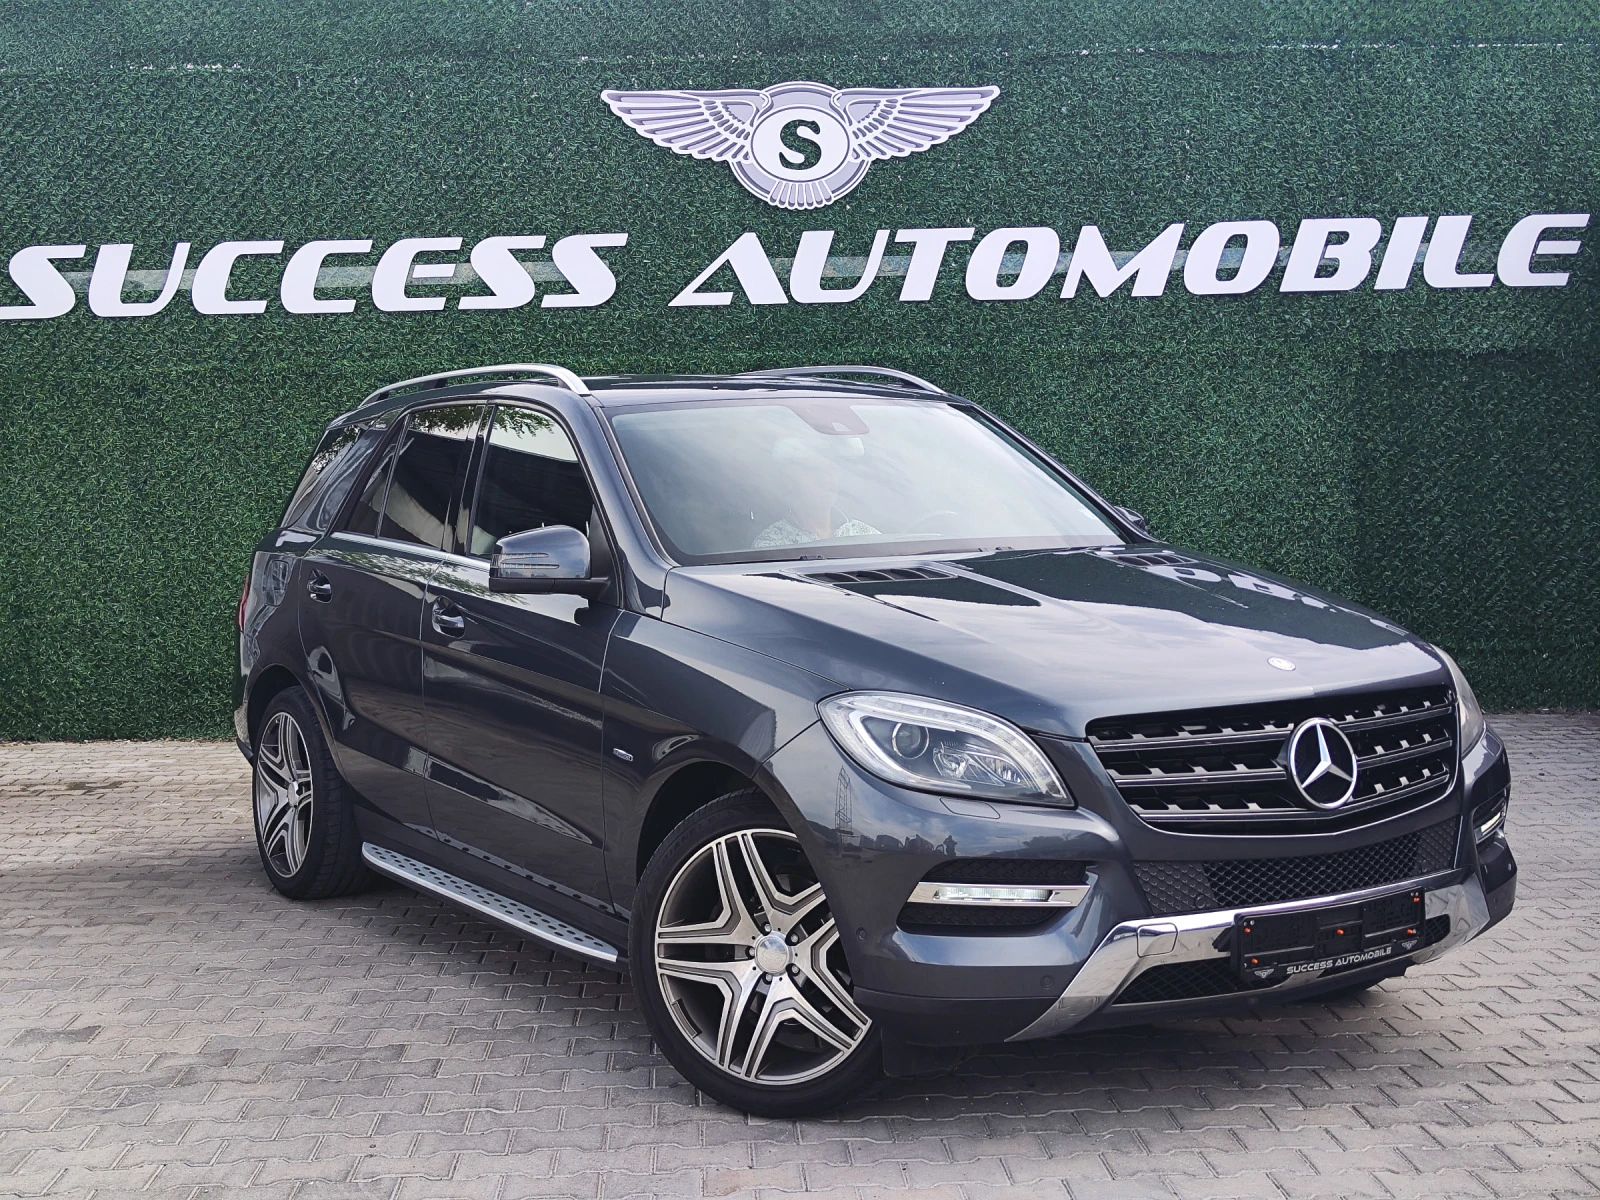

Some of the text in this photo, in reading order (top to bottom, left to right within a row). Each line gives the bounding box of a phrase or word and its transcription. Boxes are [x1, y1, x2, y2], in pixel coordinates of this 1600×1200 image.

[779, 119, 821, 170] S
[0, 213, 1590, 320] SUCCESS AUTOMOBILE
[1286, 947, 1392, 974] SUCCESS AUTOMOBILE
